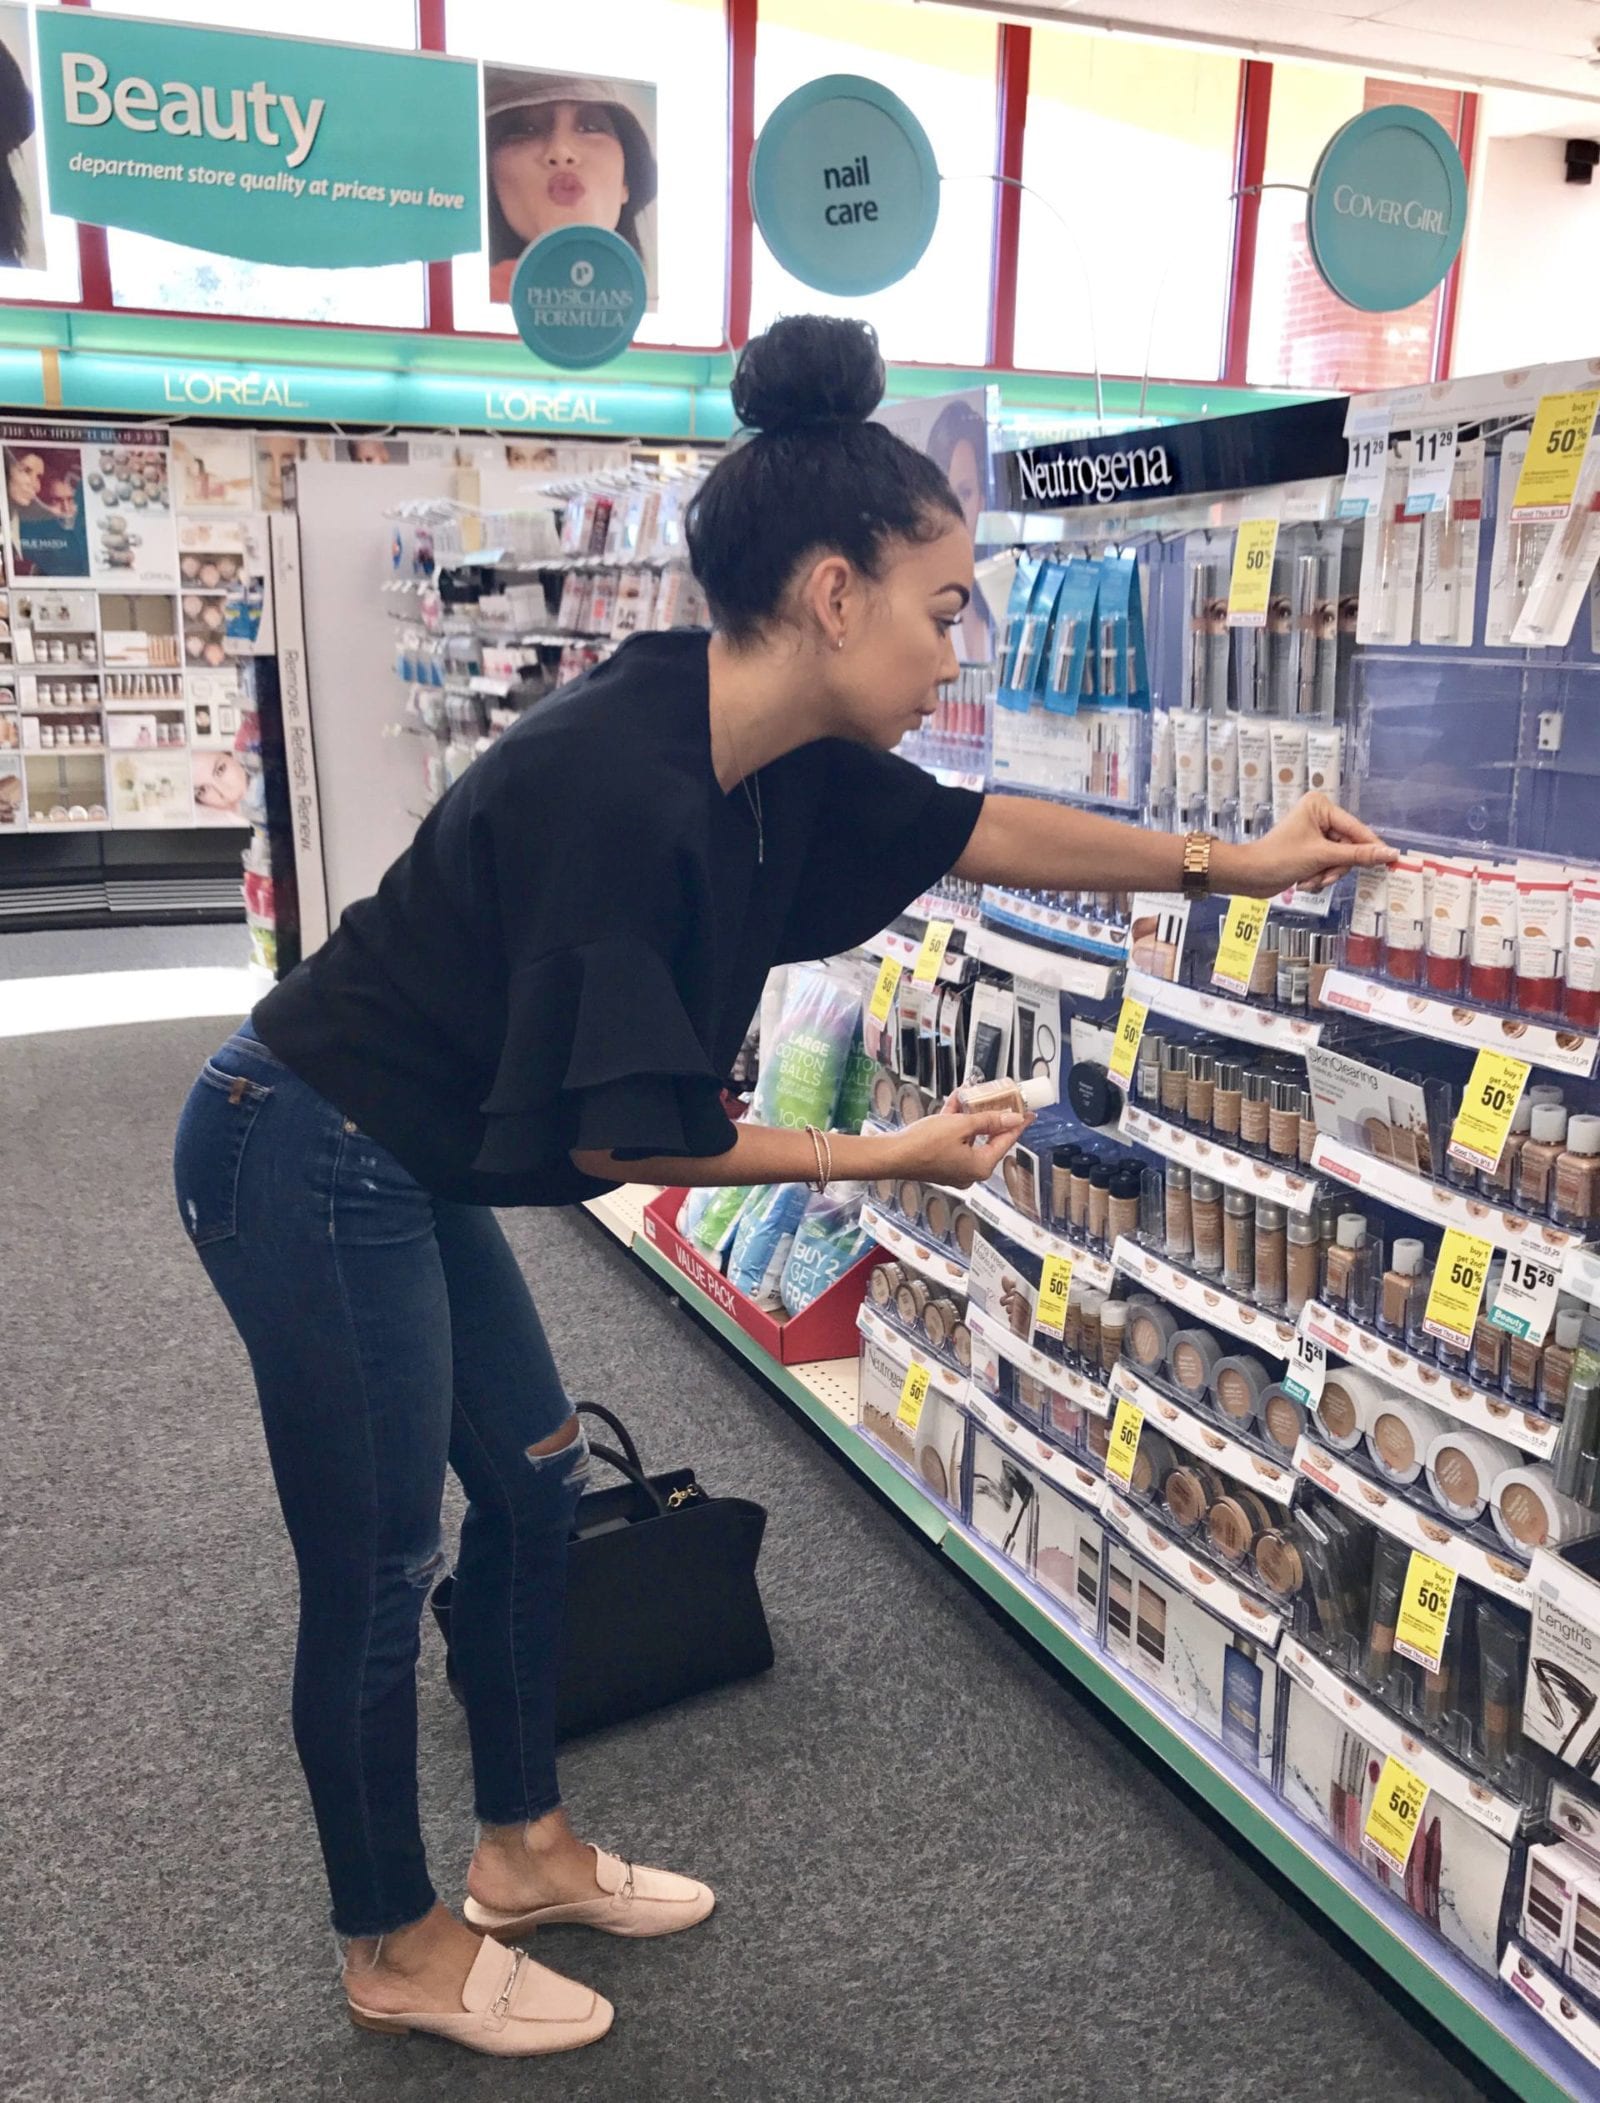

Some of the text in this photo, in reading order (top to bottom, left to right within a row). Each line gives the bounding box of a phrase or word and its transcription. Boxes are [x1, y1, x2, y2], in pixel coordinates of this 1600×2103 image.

[61, 52, 325, 168] Beauty
[69, 153, 465, 209] department store quality at prices you love
[824, 155, 870, 190] nail
[825, 199, 878, 226] care
[527, 287, 634, 307] PHYSICIANS
[534, 309, 625, 328] FORMULA
[1572, 402, 1586, 413] buy
[1547, 428, 1588, 454] 50%
[1016, 445, 1173, 503] Neutrogena
[1235, 920, 1260, 941] 50%
[788, 1031, 830, 1057] LARGE
[776, 1043, 825, 1072] COTTON
[1308, 1048, 1379, 1091] SkinClearing
[780, 1061, 821, 1086] BALLS
[1489, 1077, 1501, 1085] get
[1504, 1068, 1516, 1080] buy
[1481, 1085, 1515, 1111] 50%
[794, 1242, 840, 1275] BUY 2
[1457, 1255, 1469, 1263] get
[1470, 1246, 1483, 1258] buy
[675, 1243, 738, 1317] VALUE PACK
[790, 1263, 821, 1291] GET
[1049, 1278, 1069, 1296] 50%
[1451, 1263, 1483, 1288] 50%
[1494, 1309, 1525, 1329] Beauty
[869, 1348, 905, 1390] Neutrogen
[1120, 1425, 1137, 1446] 50%
[1423, 1579, 1434, 1590] get
[1434, 1571, 1447, 1584] buy
[1418, 1587, 1448, 1613] 50%
[1539, 1606, 1592, 1650] Lengths
[1408, 1780, 1419, 1795] buy
[1389, 1791, 1418, 1819] 50%
